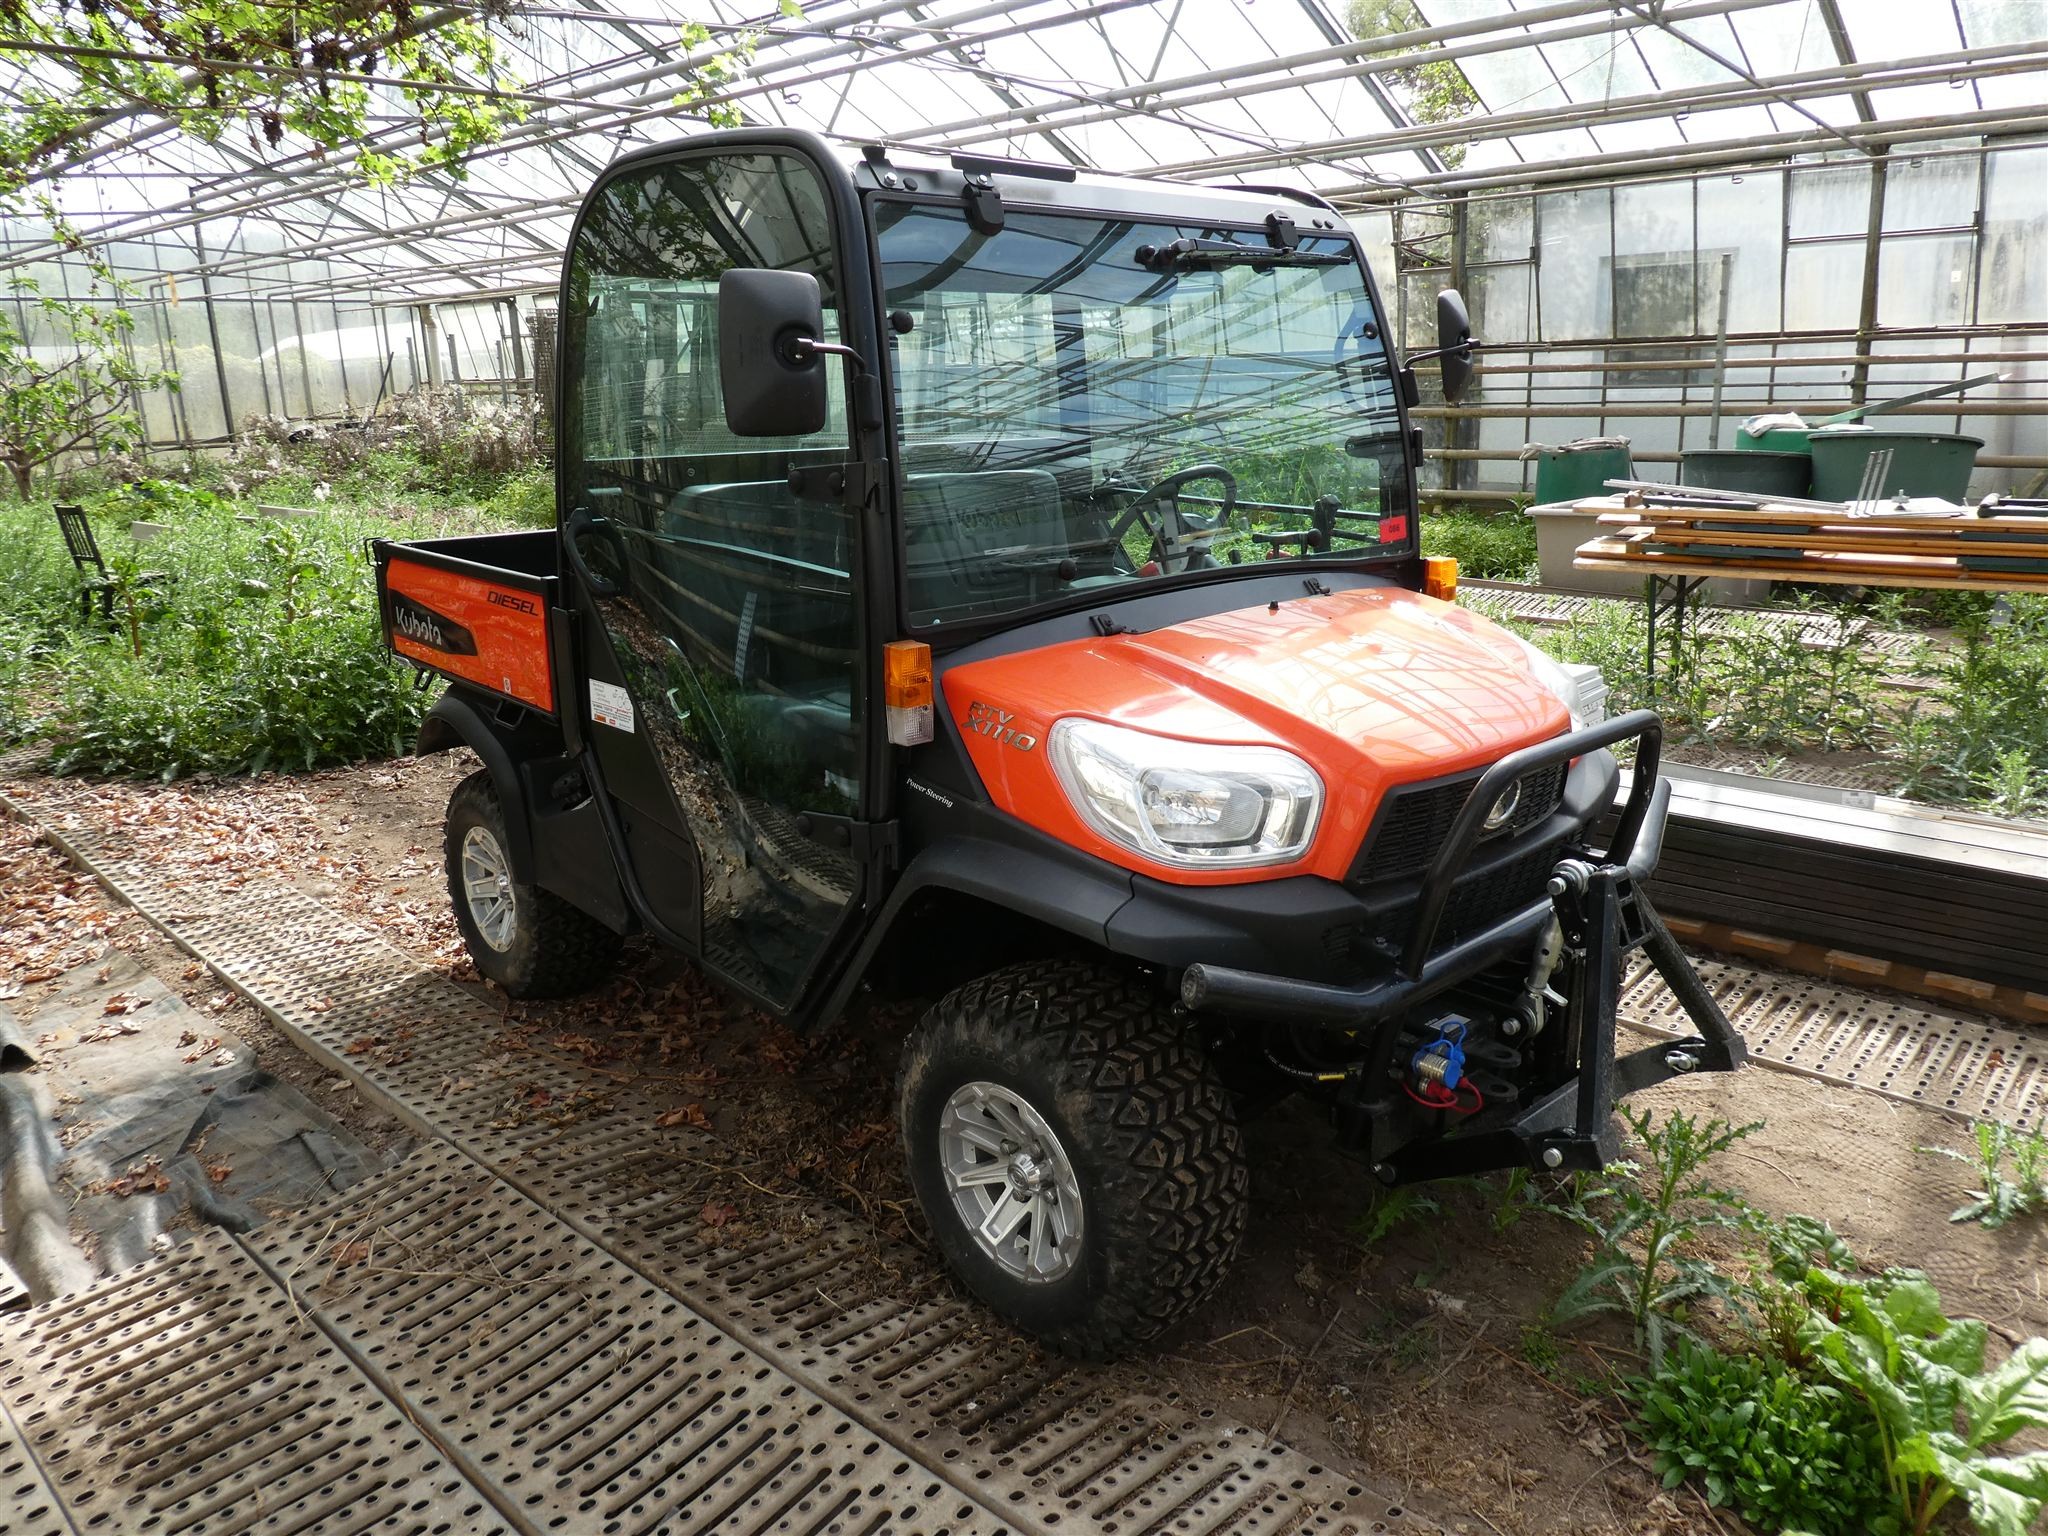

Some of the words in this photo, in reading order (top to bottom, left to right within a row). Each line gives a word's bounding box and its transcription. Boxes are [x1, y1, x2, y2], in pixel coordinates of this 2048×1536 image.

[487, 591, 538, 616] DIESEL
[395, 605, 442, 646] Kubota
[969, 701, 1015, 724] RTV
[963, 712, 1037, 751] X1110
[906, 777, 926, 793] Power
[926, 788, 954, 808] Steering
